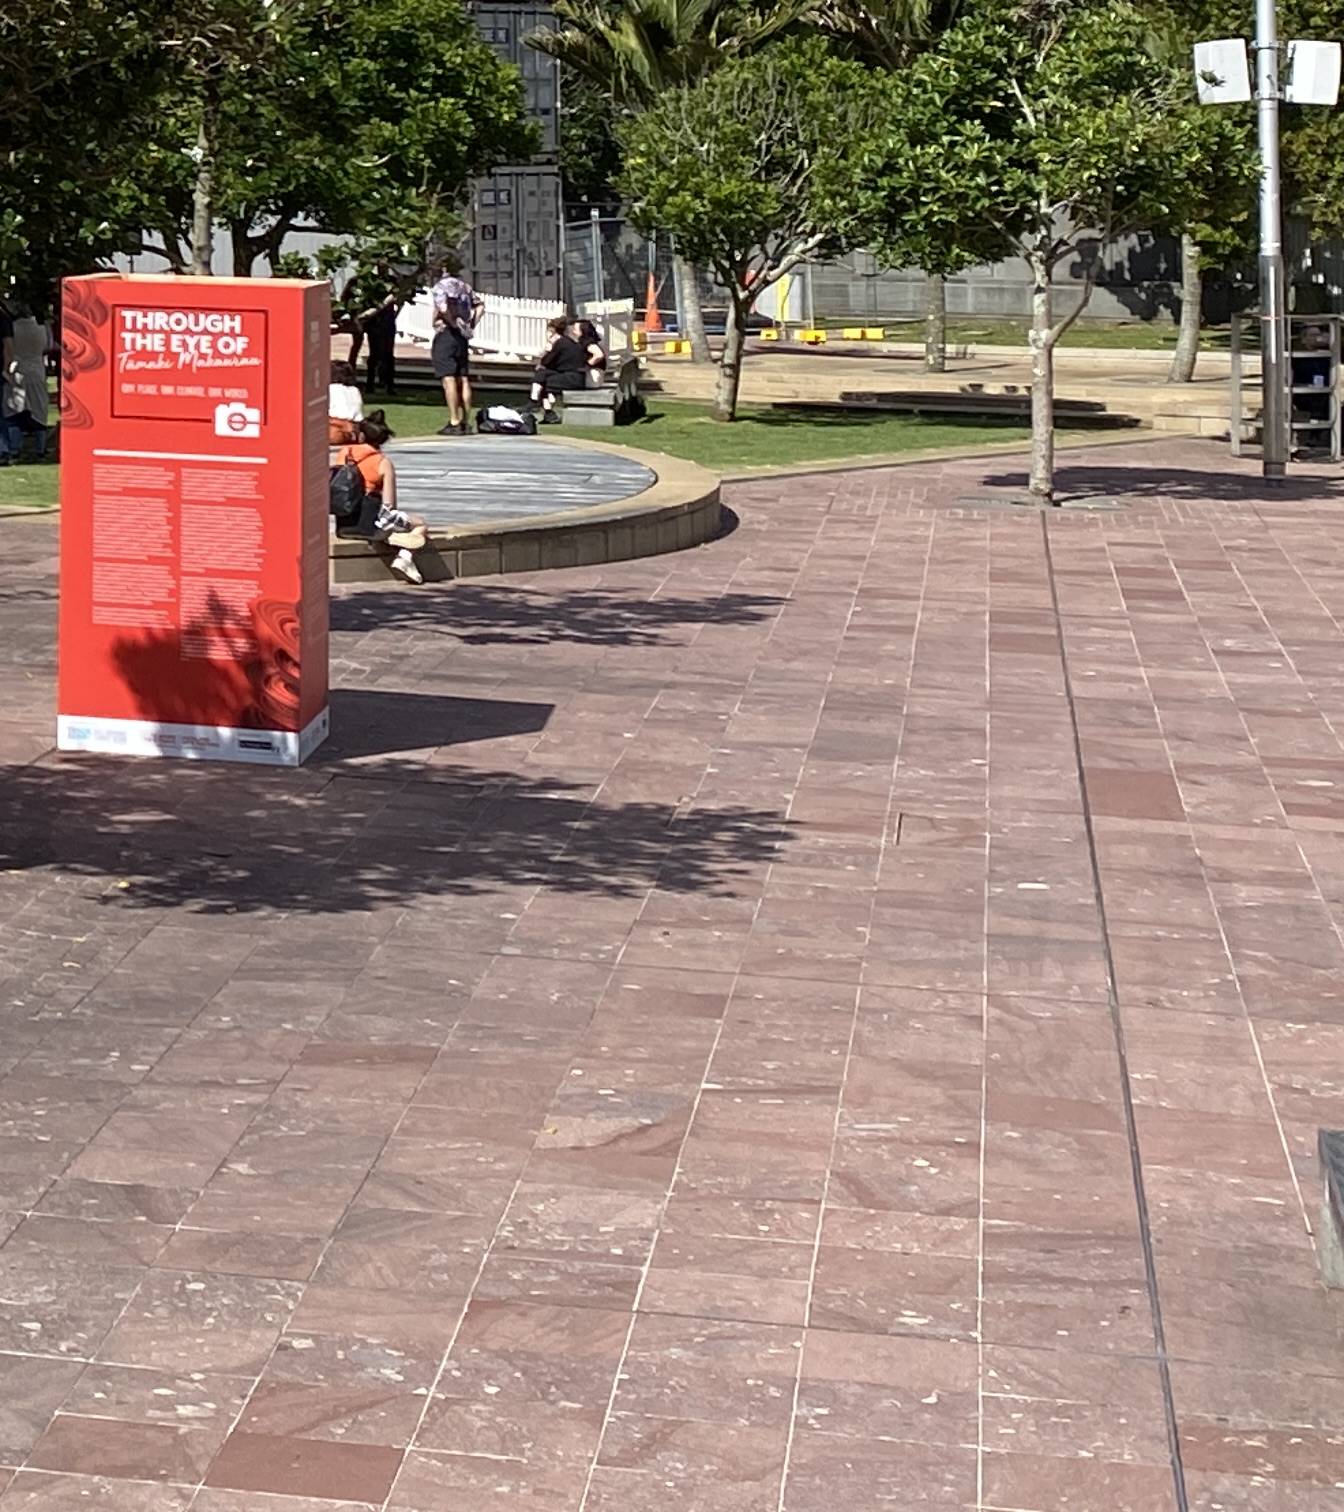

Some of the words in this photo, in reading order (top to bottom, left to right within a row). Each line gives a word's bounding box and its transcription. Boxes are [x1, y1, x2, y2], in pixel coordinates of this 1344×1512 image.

[120, 309, 242, 335] THROUGH
[120, 331, 166, 352] THE
[170, 334, 214, 355] EYE
[217, 336, 250, 355] OF
